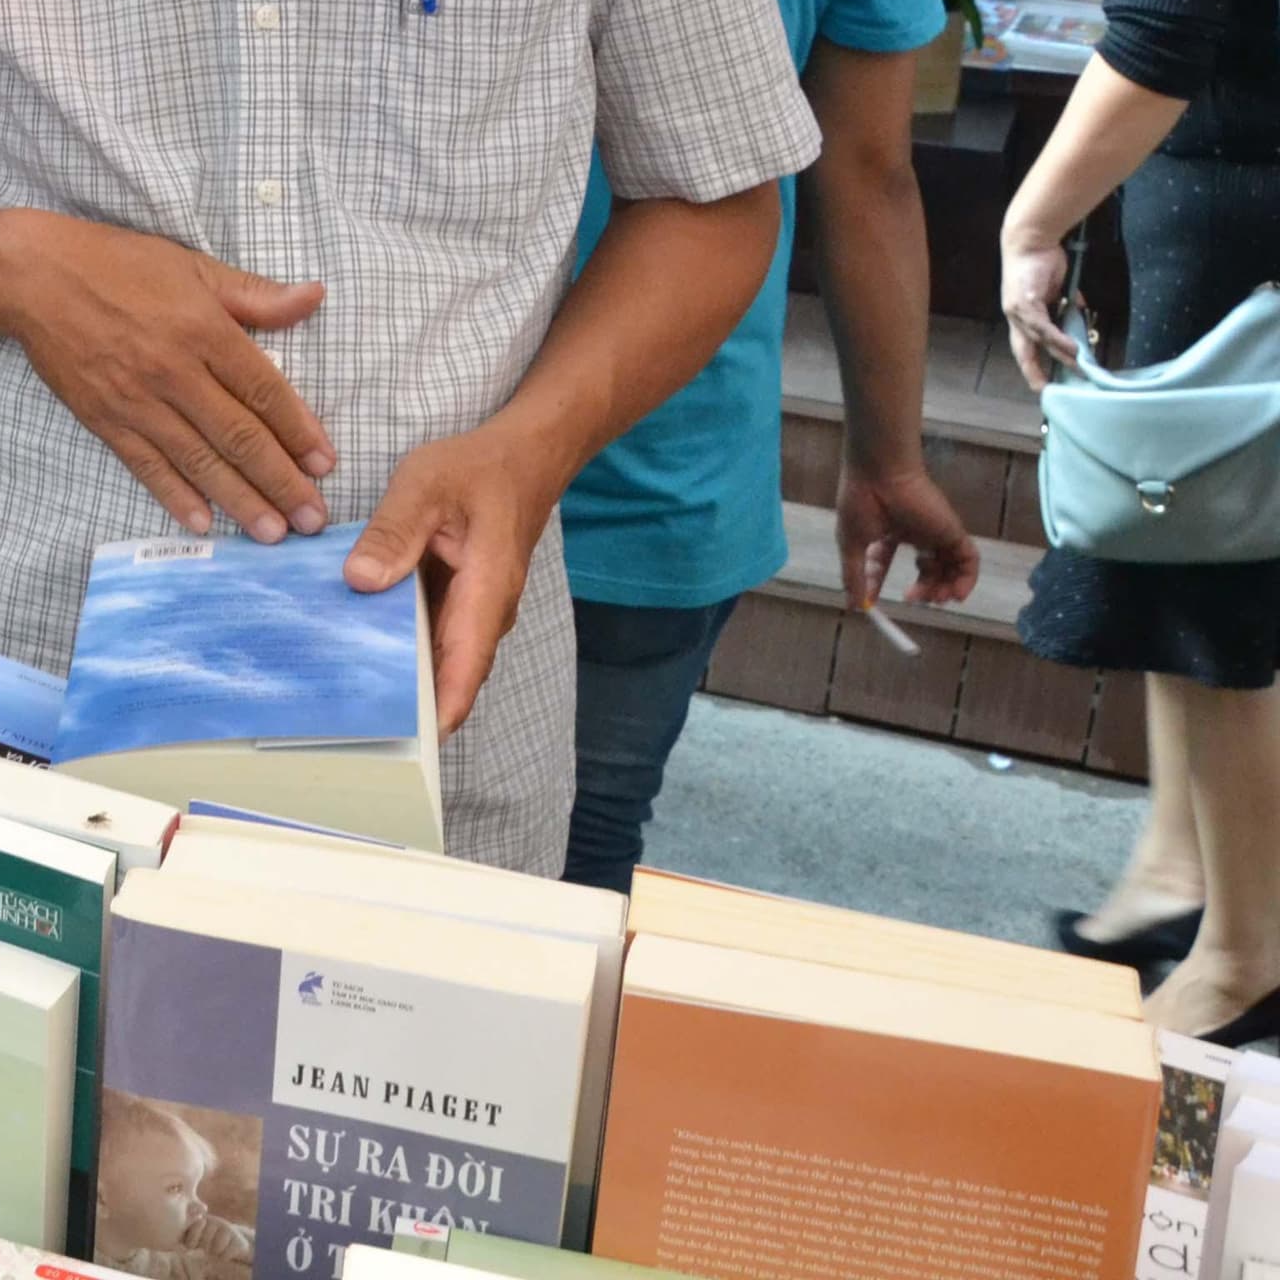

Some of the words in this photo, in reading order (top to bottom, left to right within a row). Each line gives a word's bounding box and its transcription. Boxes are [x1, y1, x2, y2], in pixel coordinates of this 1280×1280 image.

[291, 1063, 370, 1100] JEAN
[383, 1080, 504, 1128] PIAGET
[287, 1123, 346, 1174] SỰ
[356, 1136, 411, 1184] RA
[424, 1150, 505, 1204] ĐỜI
[282, 1177, 357, 1227] TRÍ
[285, 1227, 313, 1272] Ở
